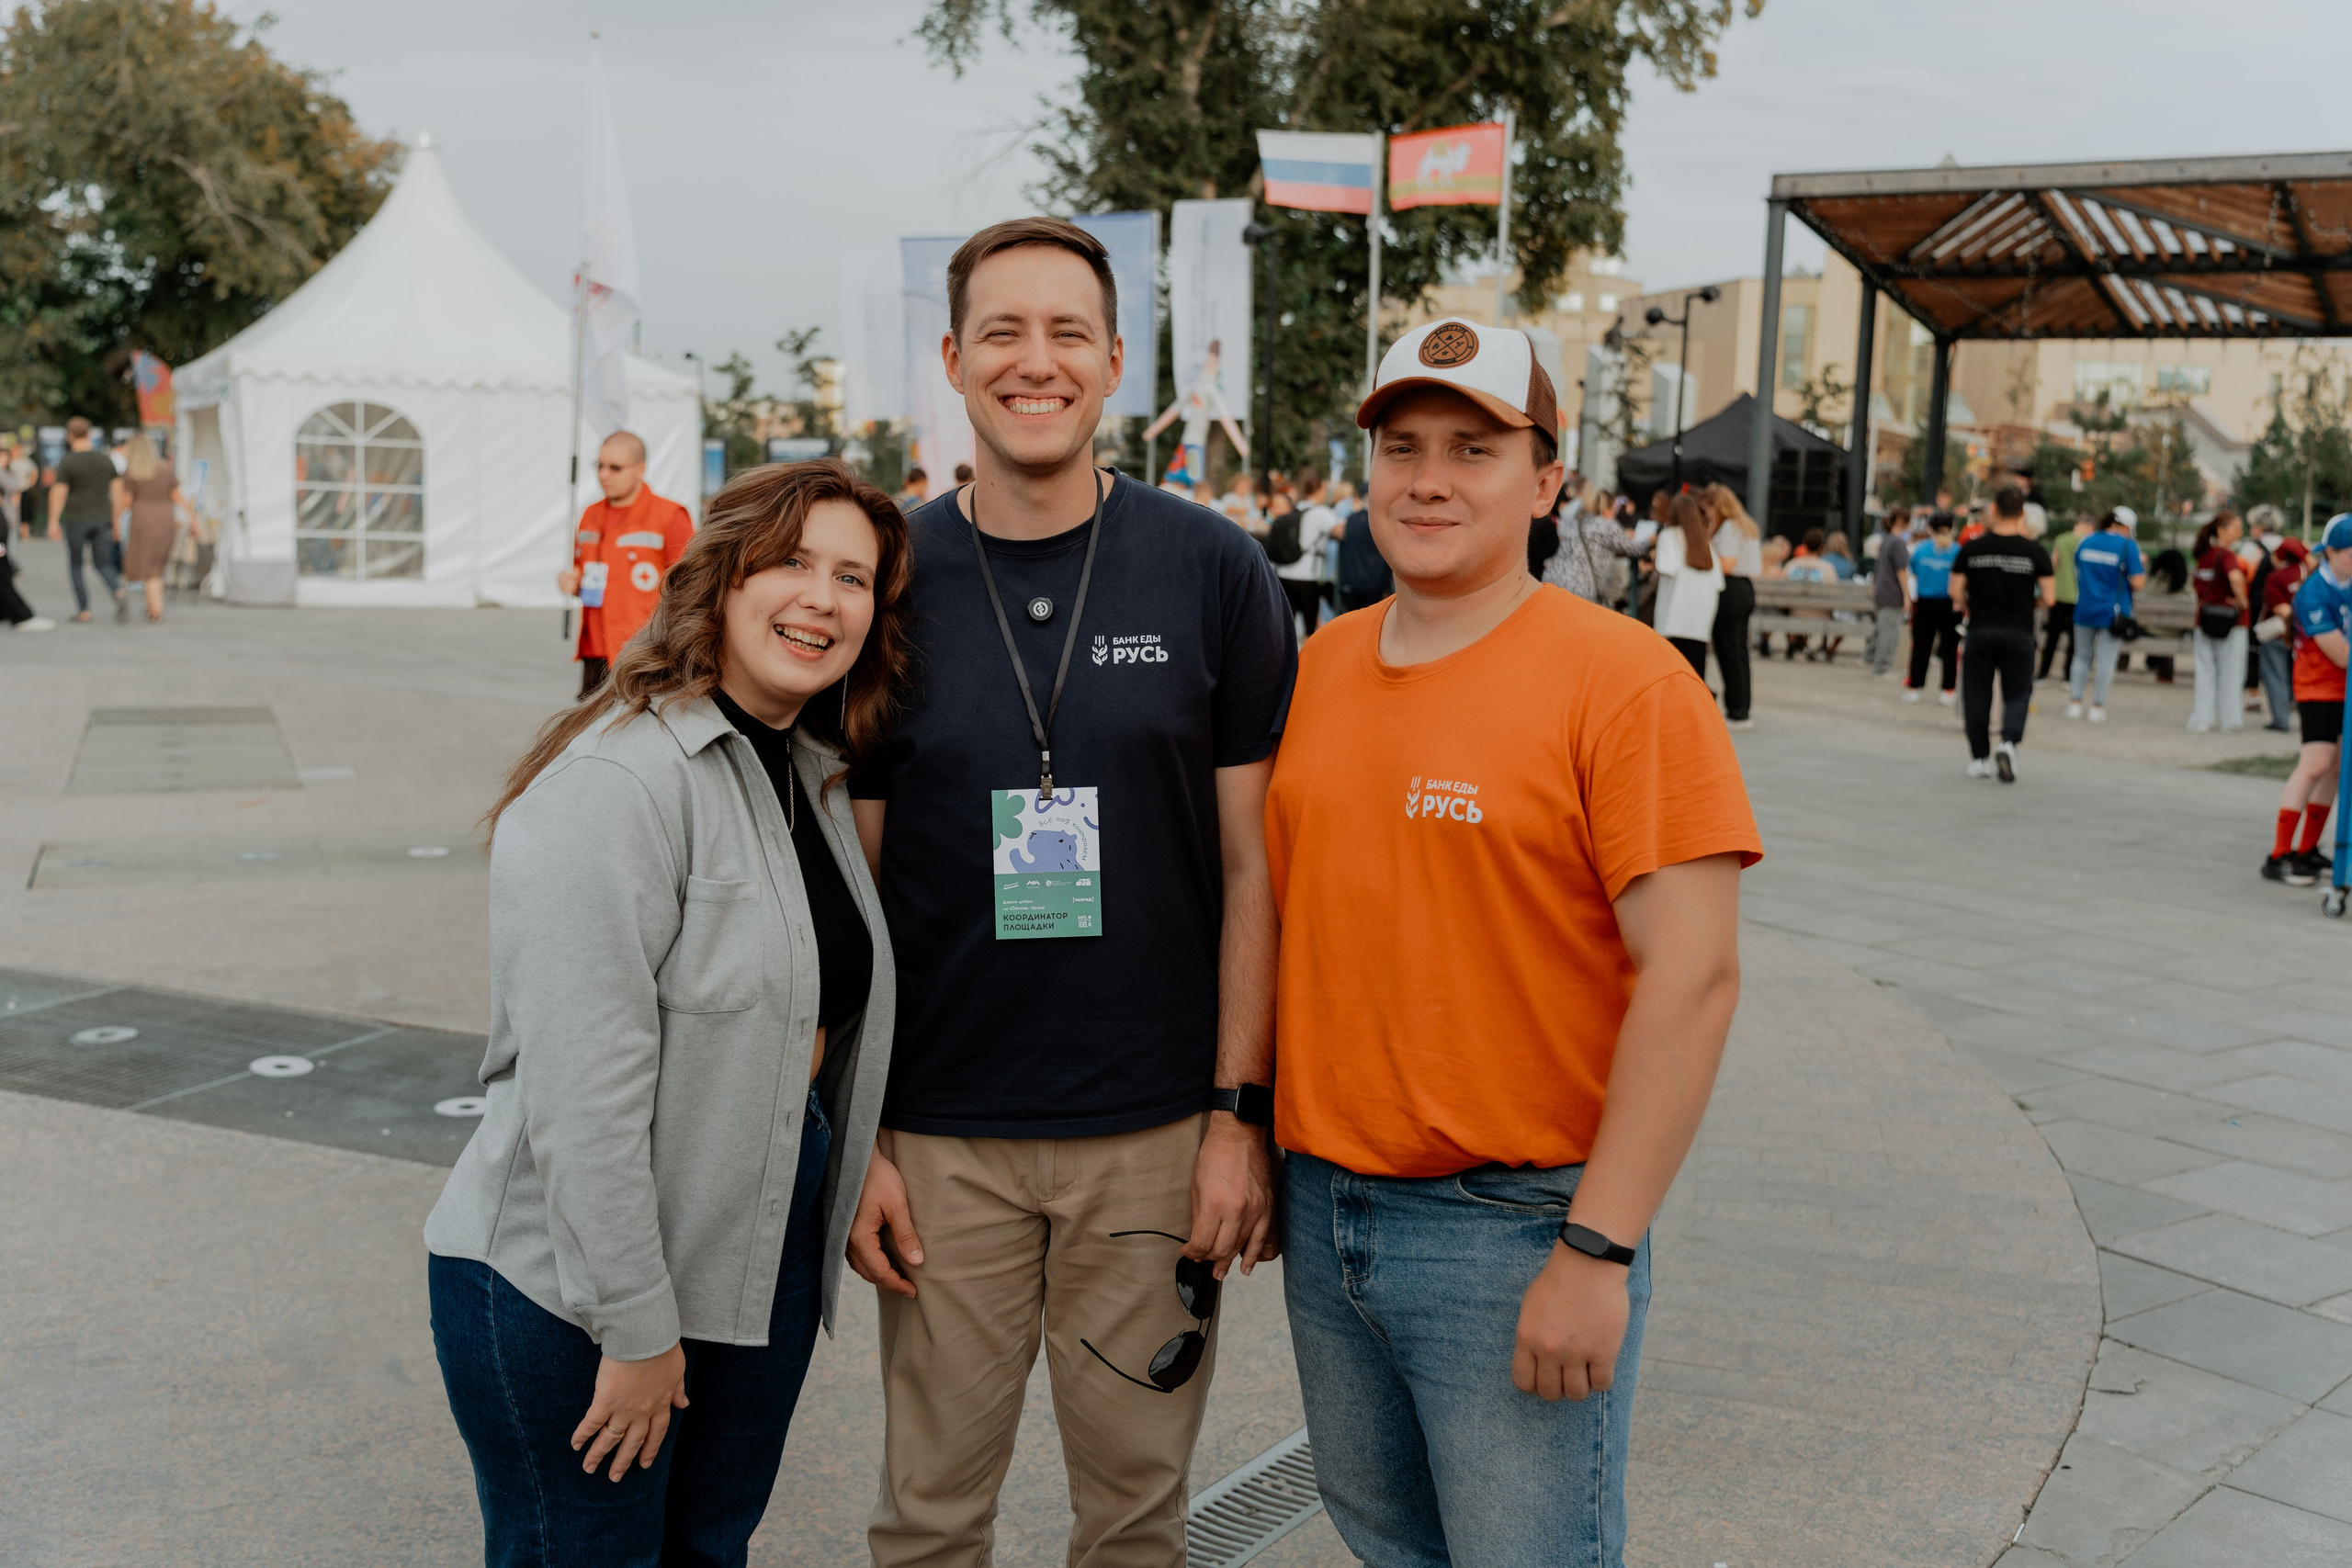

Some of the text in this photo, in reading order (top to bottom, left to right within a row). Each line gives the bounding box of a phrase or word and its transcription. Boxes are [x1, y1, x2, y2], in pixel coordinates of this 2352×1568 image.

[1113, 635, 1160, 645] БАНК ЕДЫ
[1113, 646, 1169, 664] РУСЬ
[1426, 779, 1478, 795] БАНК ЕДЫ
[1422, 795, 1483, 824] РУСЬ
[1003, 912, 1069, 921] КООРДИНАТОР
[1003, 922, 1055, 931] ПЛОЩАДКИ
[1078, 920, 1092, 929] 100.4
